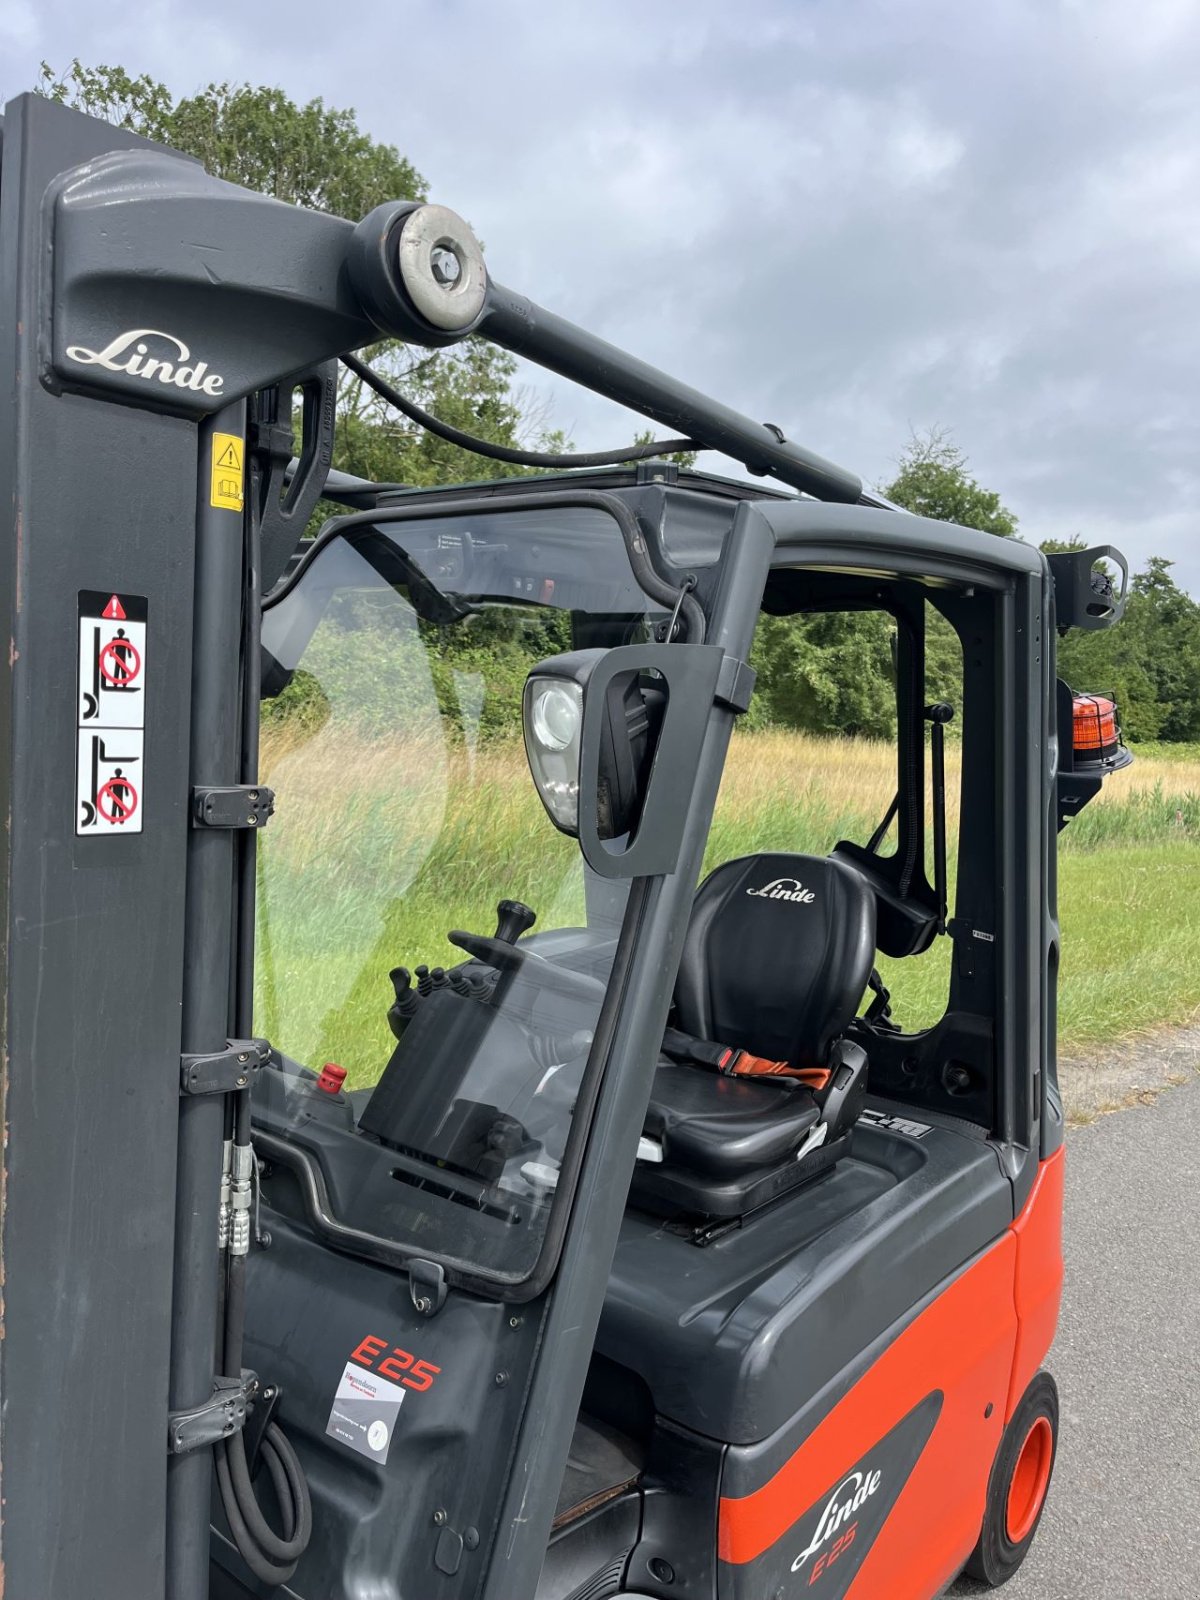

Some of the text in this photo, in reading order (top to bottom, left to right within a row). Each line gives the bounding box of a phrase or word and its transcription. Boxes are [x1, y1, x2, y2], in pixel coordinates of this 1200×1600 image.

[65, 329, 225, 397] Linde
[745, 878, 816, 904] Linde
[790, 1469, 882, 1573] Linde
